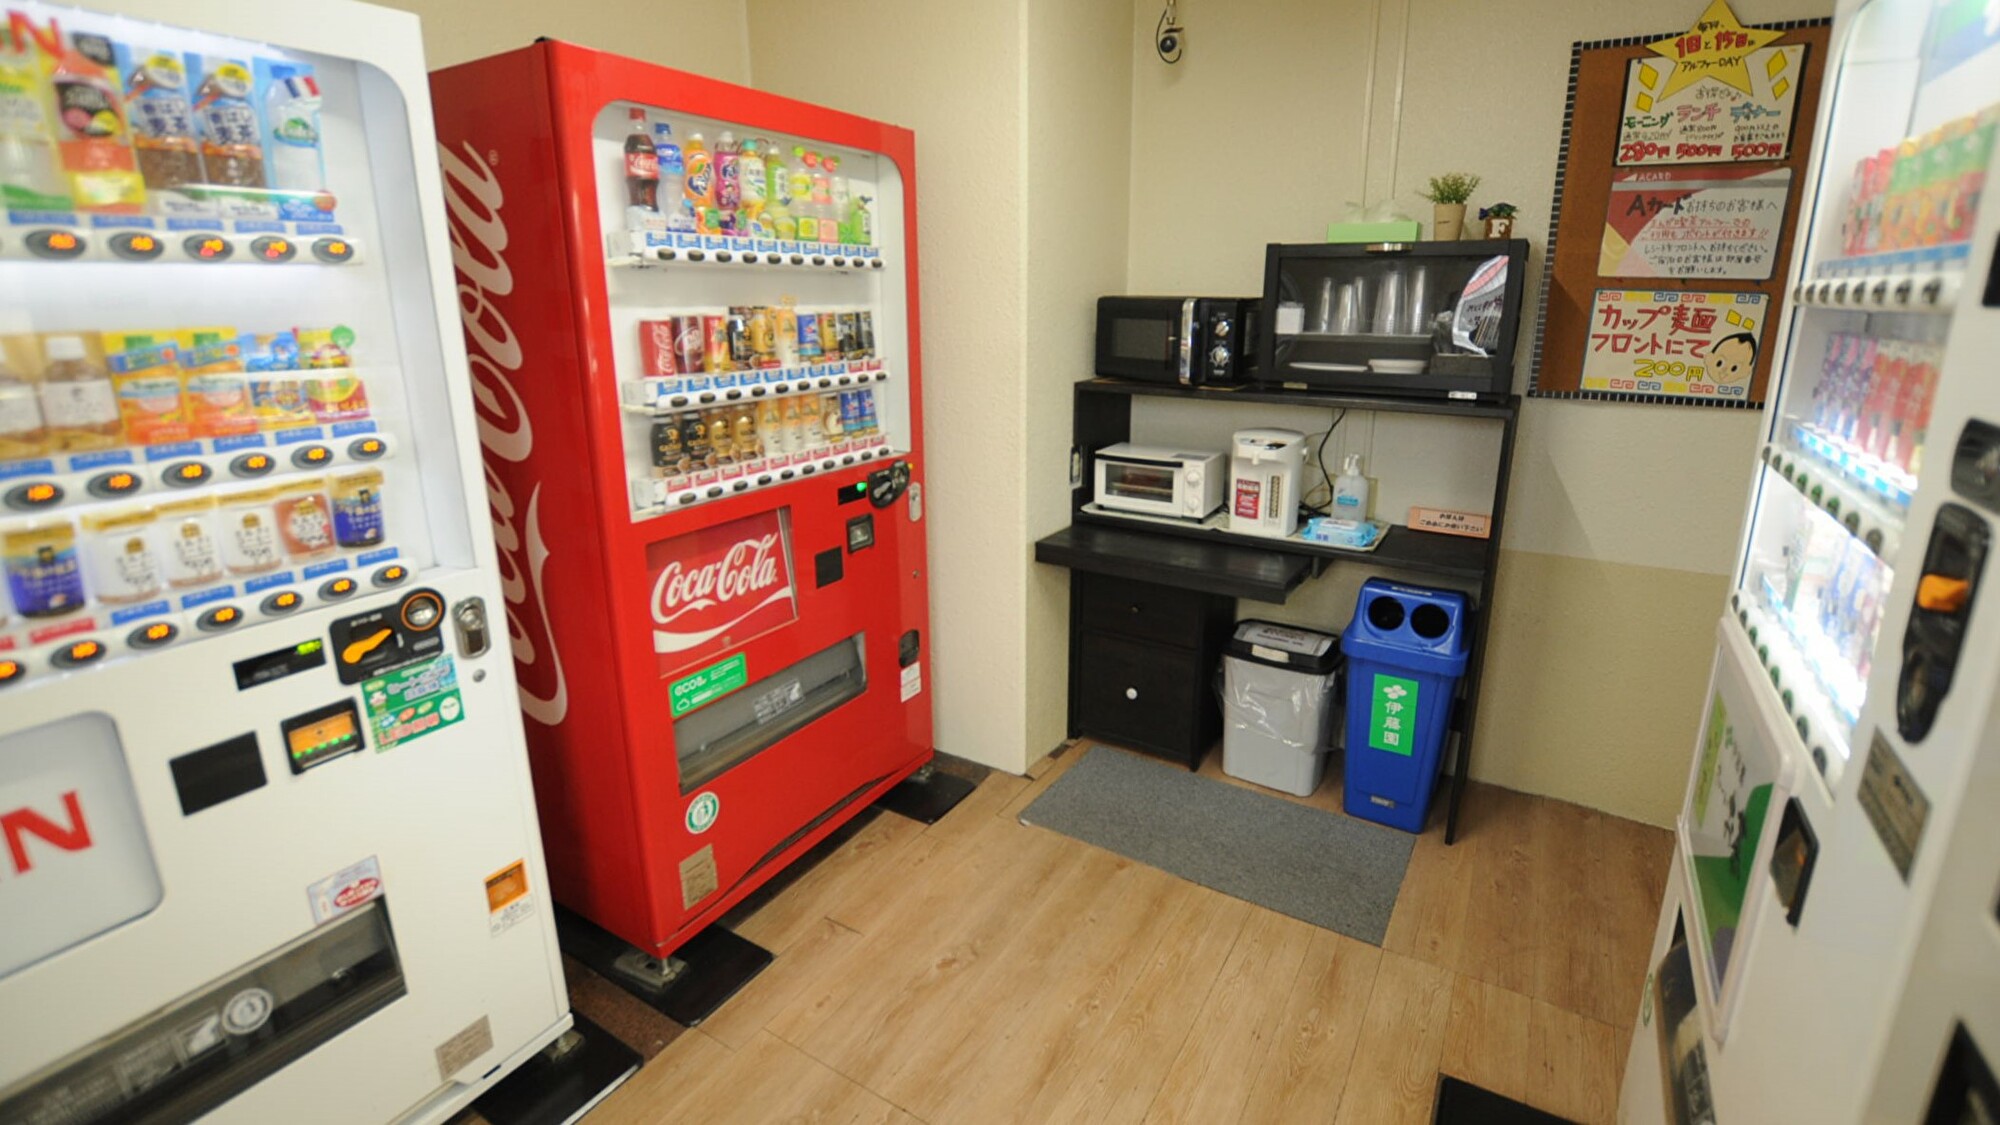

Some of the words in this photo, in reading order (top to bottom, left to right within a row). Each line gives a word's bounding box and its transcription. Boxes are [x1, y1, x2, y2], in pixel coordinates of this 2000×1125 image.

[0, 10, 65, 59] N
[1624, 111, 1673, 129] モーニング
[1676, 102, 1721, 123] ランチ
[1620, 141, 1670, 162] 280円
[1676, 142, 1722, 160] 500円
[1731, 142, 1782, 160] 500円
[1489, 218, 1509, 238] F
[1598, 304, 1717, 336] カップ麺
[1591, 332, 1711, 358] フロントにて
[1634, 358, 1704, 382] 200円
[650, 533, 779, 625] Coca-Cola
[1383, 700, 1404, 747] 伊藤園
